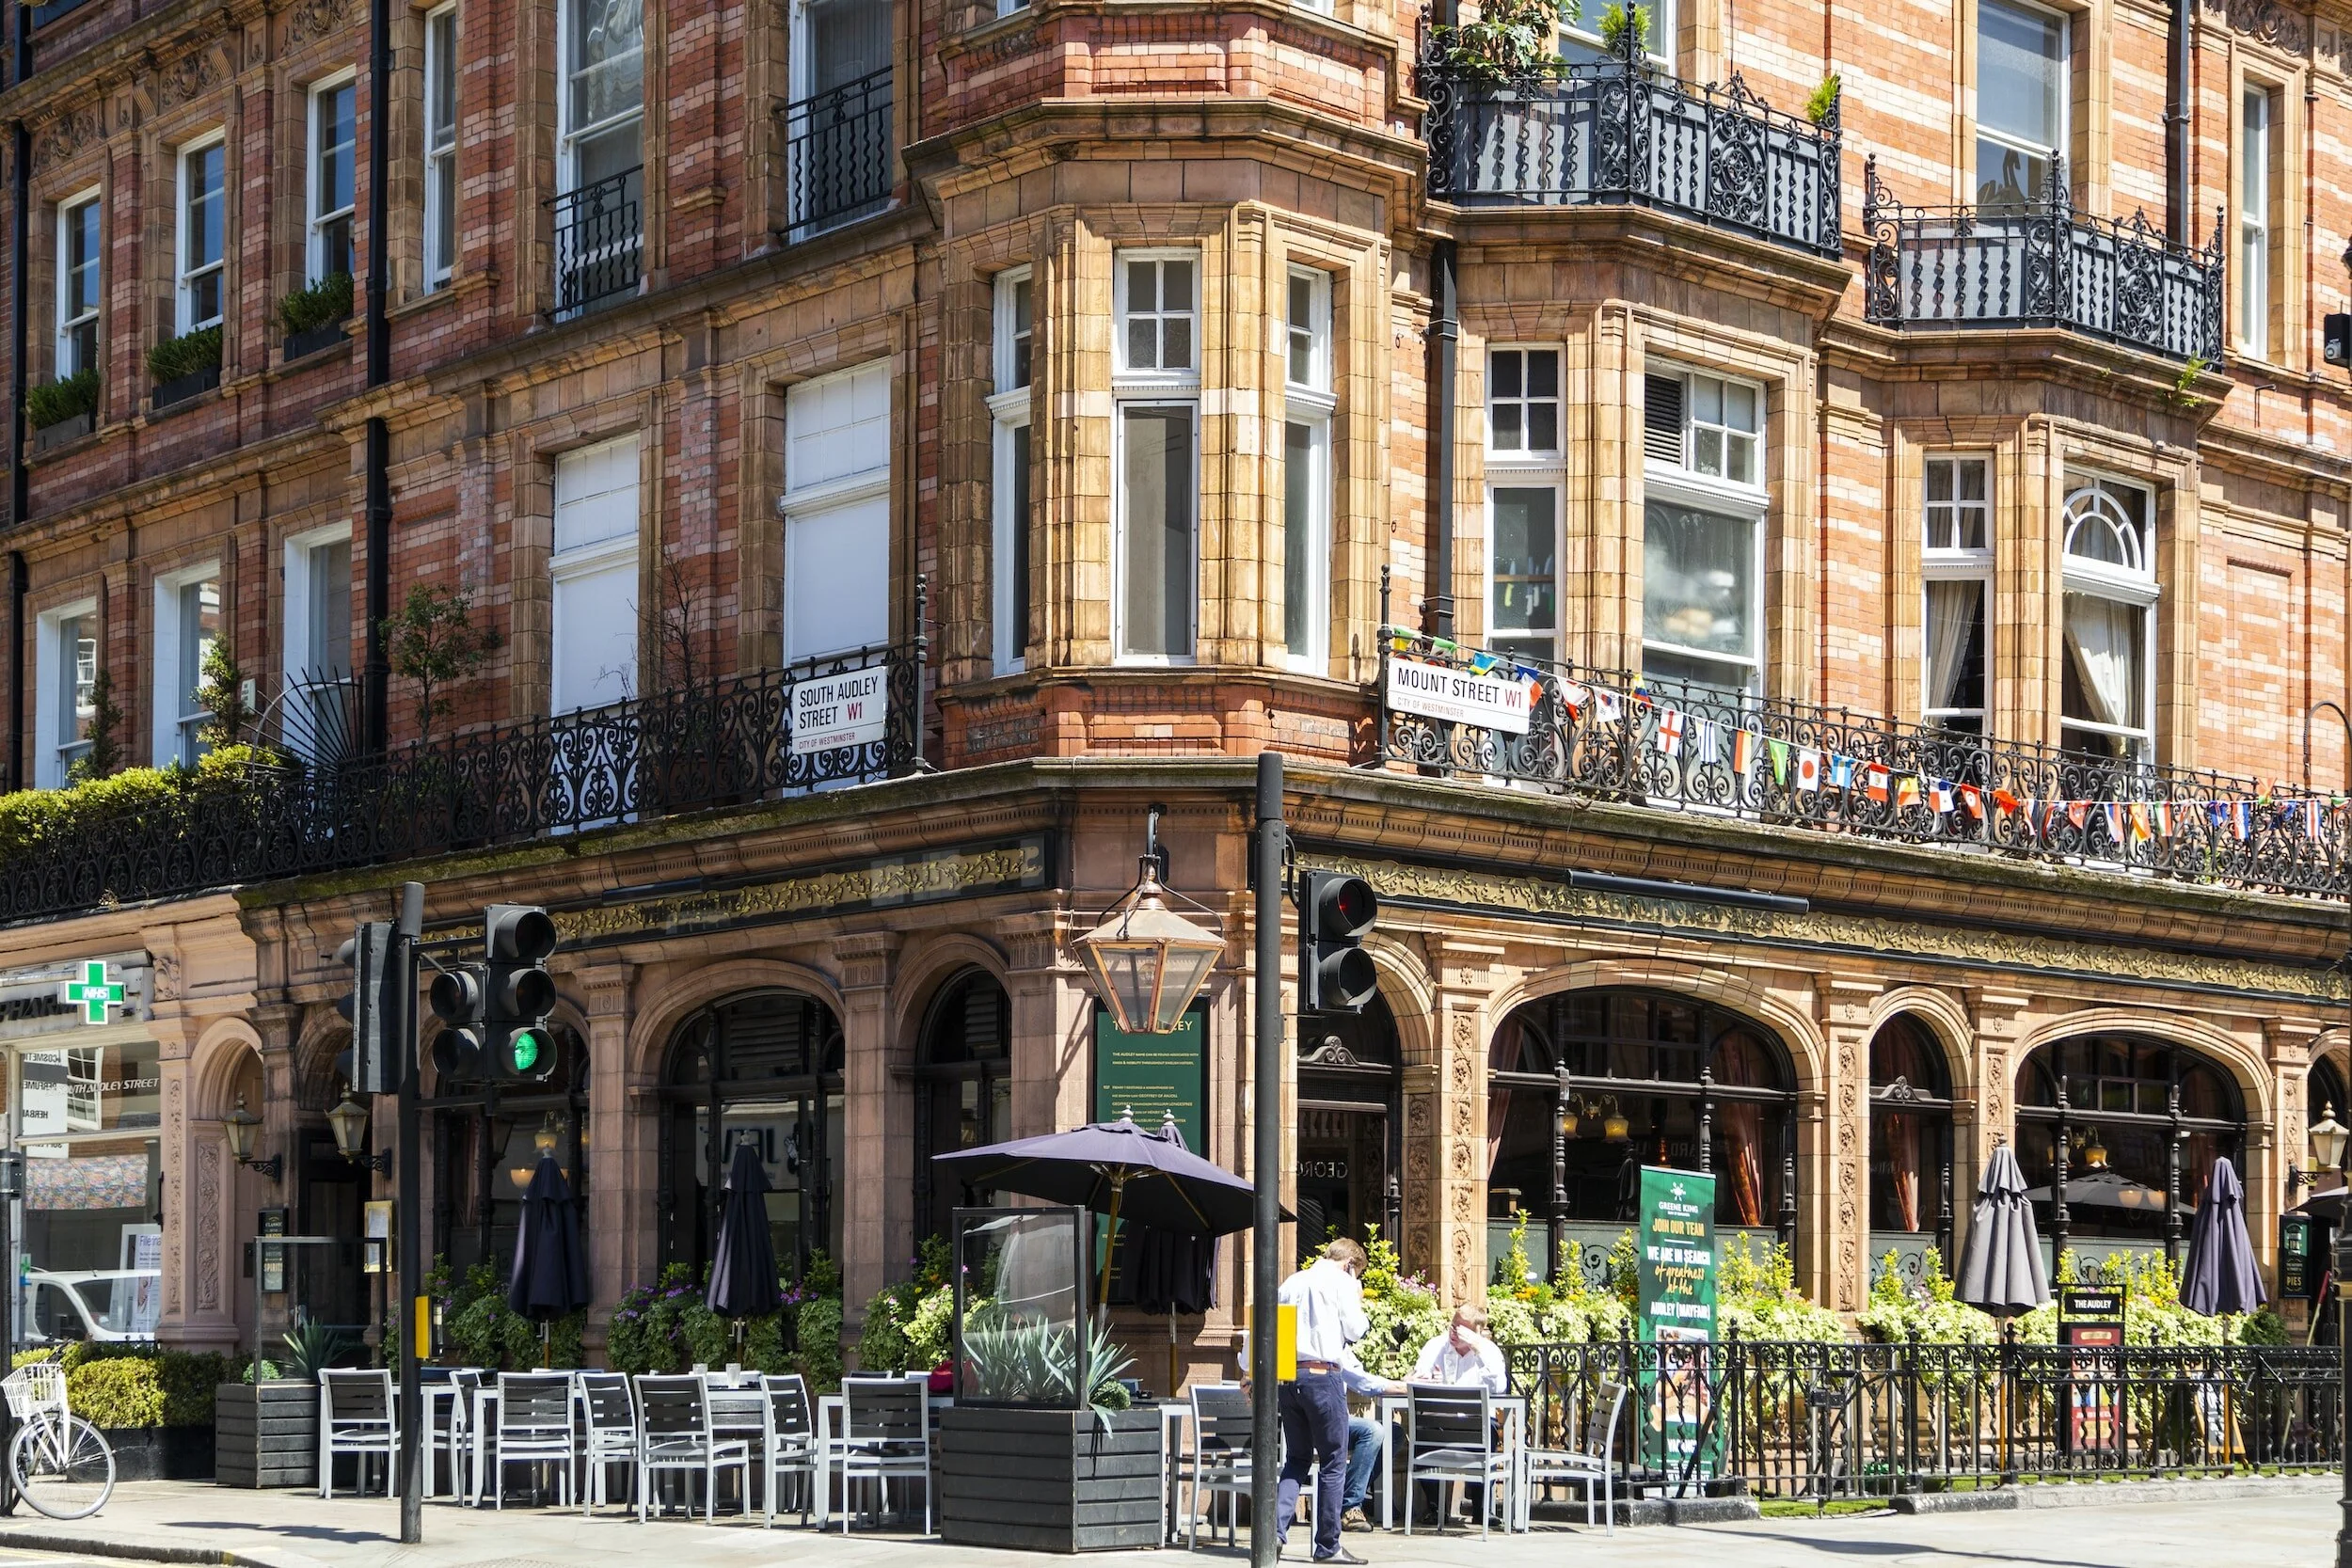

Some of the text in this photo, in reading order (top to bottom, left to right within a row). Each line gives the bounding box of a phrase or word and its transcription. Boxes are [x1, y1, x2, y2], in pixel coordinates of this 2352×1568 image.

[800, 675, 879, 707] SOUTH AUDLEY
[1398, 667, 1521, 708] MOUNT STREET W1
[799, 702, 863, 729] STREET W1
[1397, 697, 1464, 718] CITY OF WESTMINSTER
[798, 732, 855, 750] CITY OF WESTMINSTER
[84, 988, 107, 998] NHS
[123, 1077, 160, 1090] STREET
[1659, 1201, 1681, 1212] GREENE
[1682, 1204, 1699, 1213] KING
[1652, 1218, 1705, 1237] JOIN OUR TEAM
[1646, 1245, 1710, 1265] WE ARE IN SEARCH
[1655, 1260, 1705, 1285] of greatness
[1665, 1277, 1693, 1295] at the
[1650, 1301, 1676, 1317] AUDLEY
[2074, 1299, 2112, 1309] THE AUDLEY
